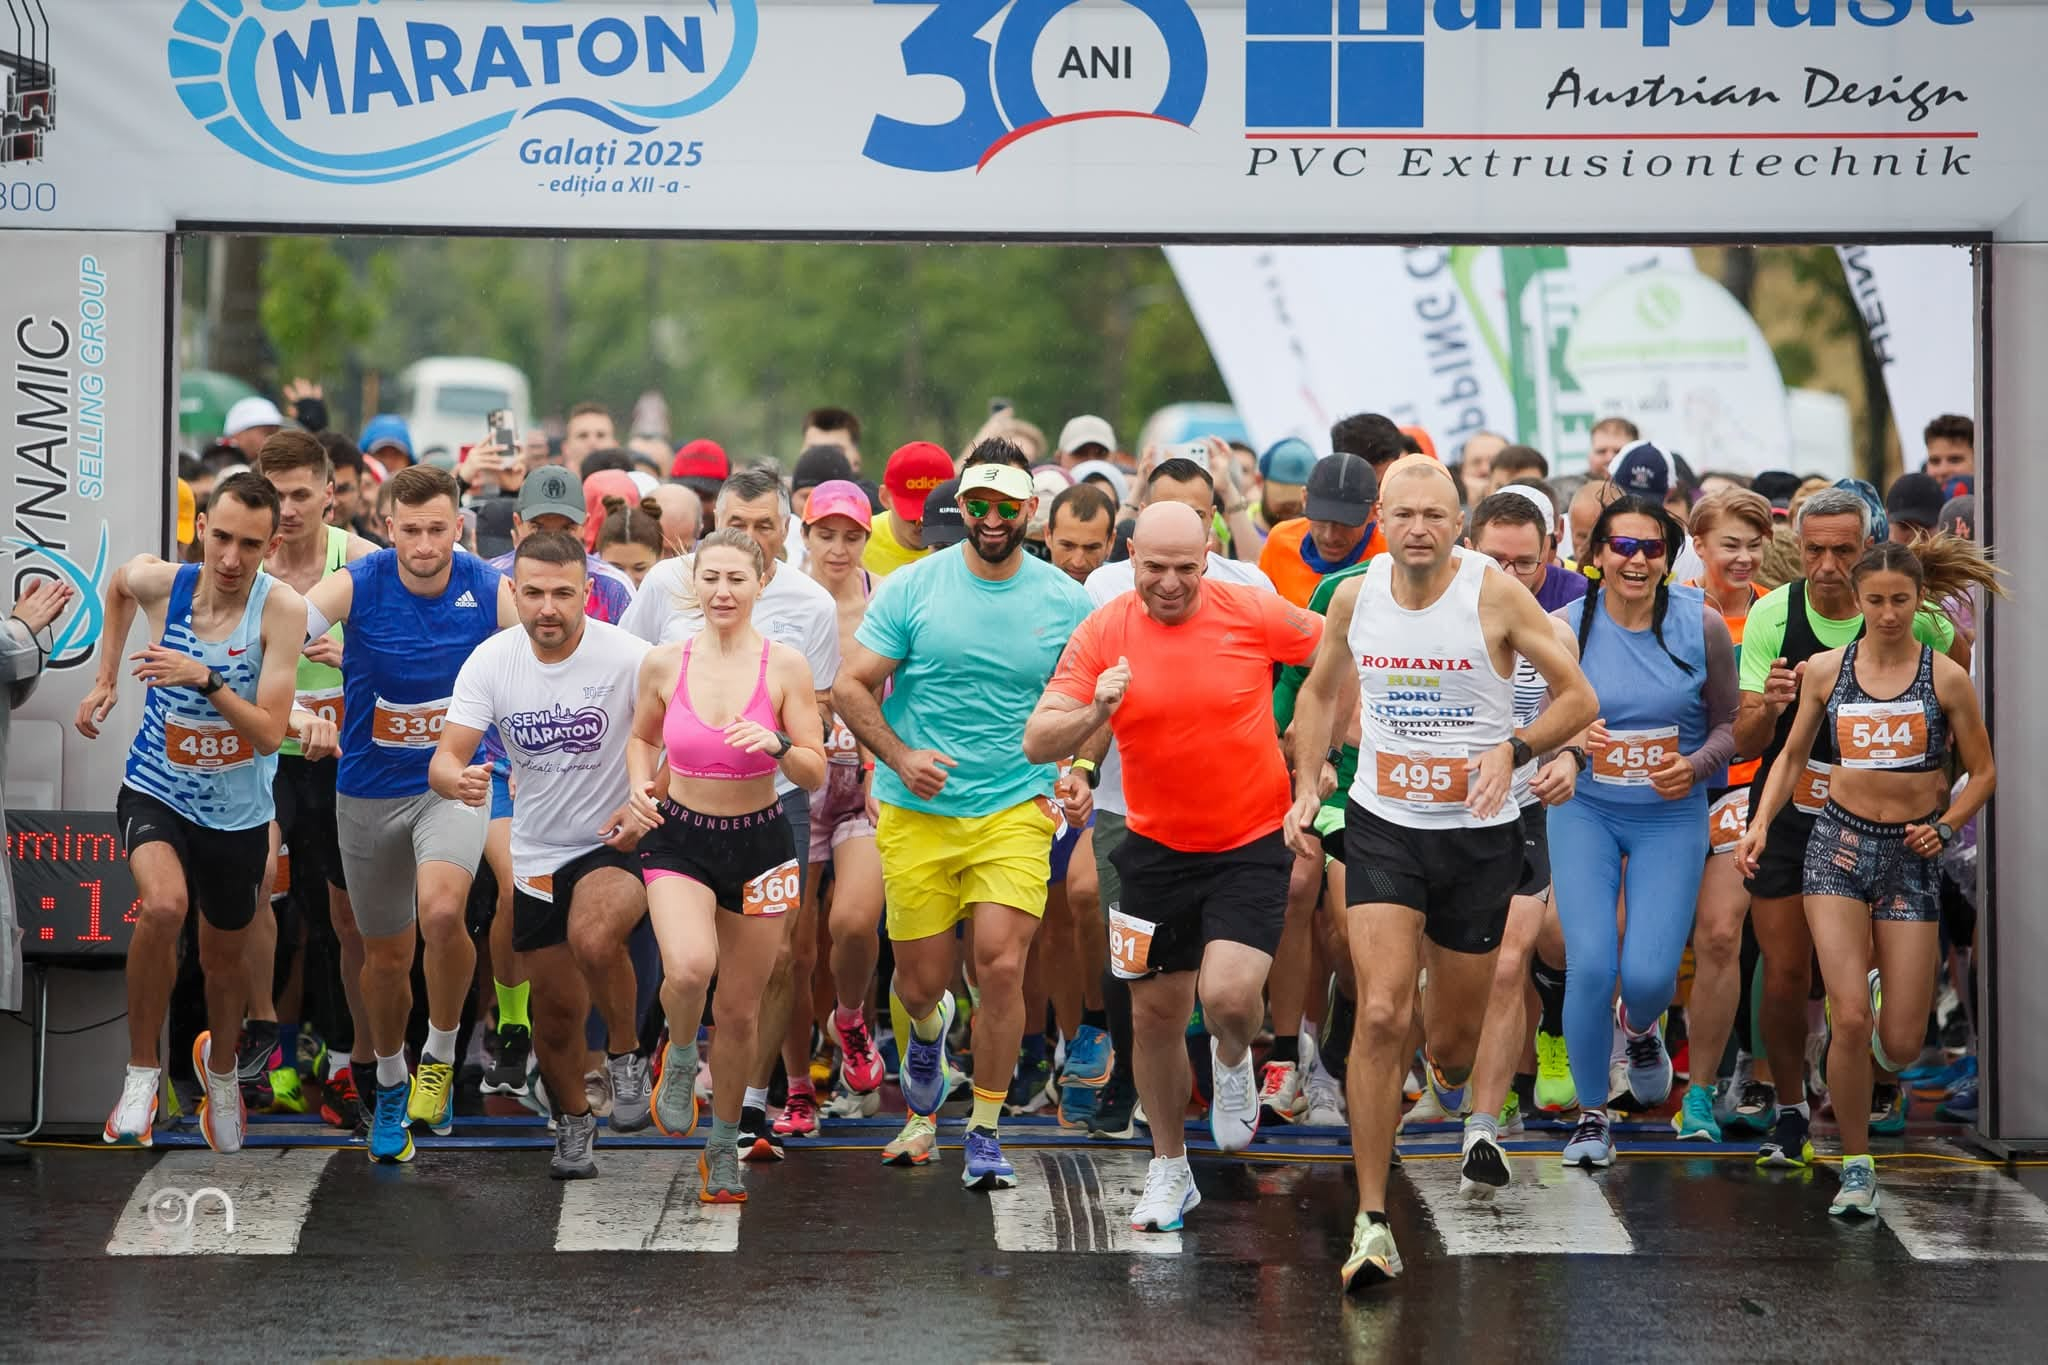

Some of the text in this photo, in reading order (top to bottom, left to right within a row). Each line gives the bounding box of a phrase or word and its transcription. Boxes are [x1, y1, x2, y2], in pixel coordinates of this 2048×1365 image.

[274, 16, 706, 121] MARATON
[1058, 46, 1132, 79] ANI
[1546, 67, 1968, 122] Austrian Design
[519, 138, 703, 174] Galați 2025
[1245, 146, 1972, 177] PVC Extrusiontechnik
[612, 180, 624, 193] a
[628, 176, 655, 193] XII
[79, 256, 106, 499] SELLING GROUP
[1362, 655, 1474, 671] ROMANIA
[1386, 674, 1441, 687] RUN
[1387, 691, 1442, 702] DORU
[388, 714, 446, 735] 330
[513, 710, 551, 727] SEMI
[516, 722, 598, 745] MARATON
[1852, 721, 1913, 748] 544
[179, 735, 240, 757] 488
[1606, 745, 1664, 768] 458
[1389, 762, 1452, 791] 495
[694, 815, 752, 831] UNDER
[746, 874, 799, 904] 360
